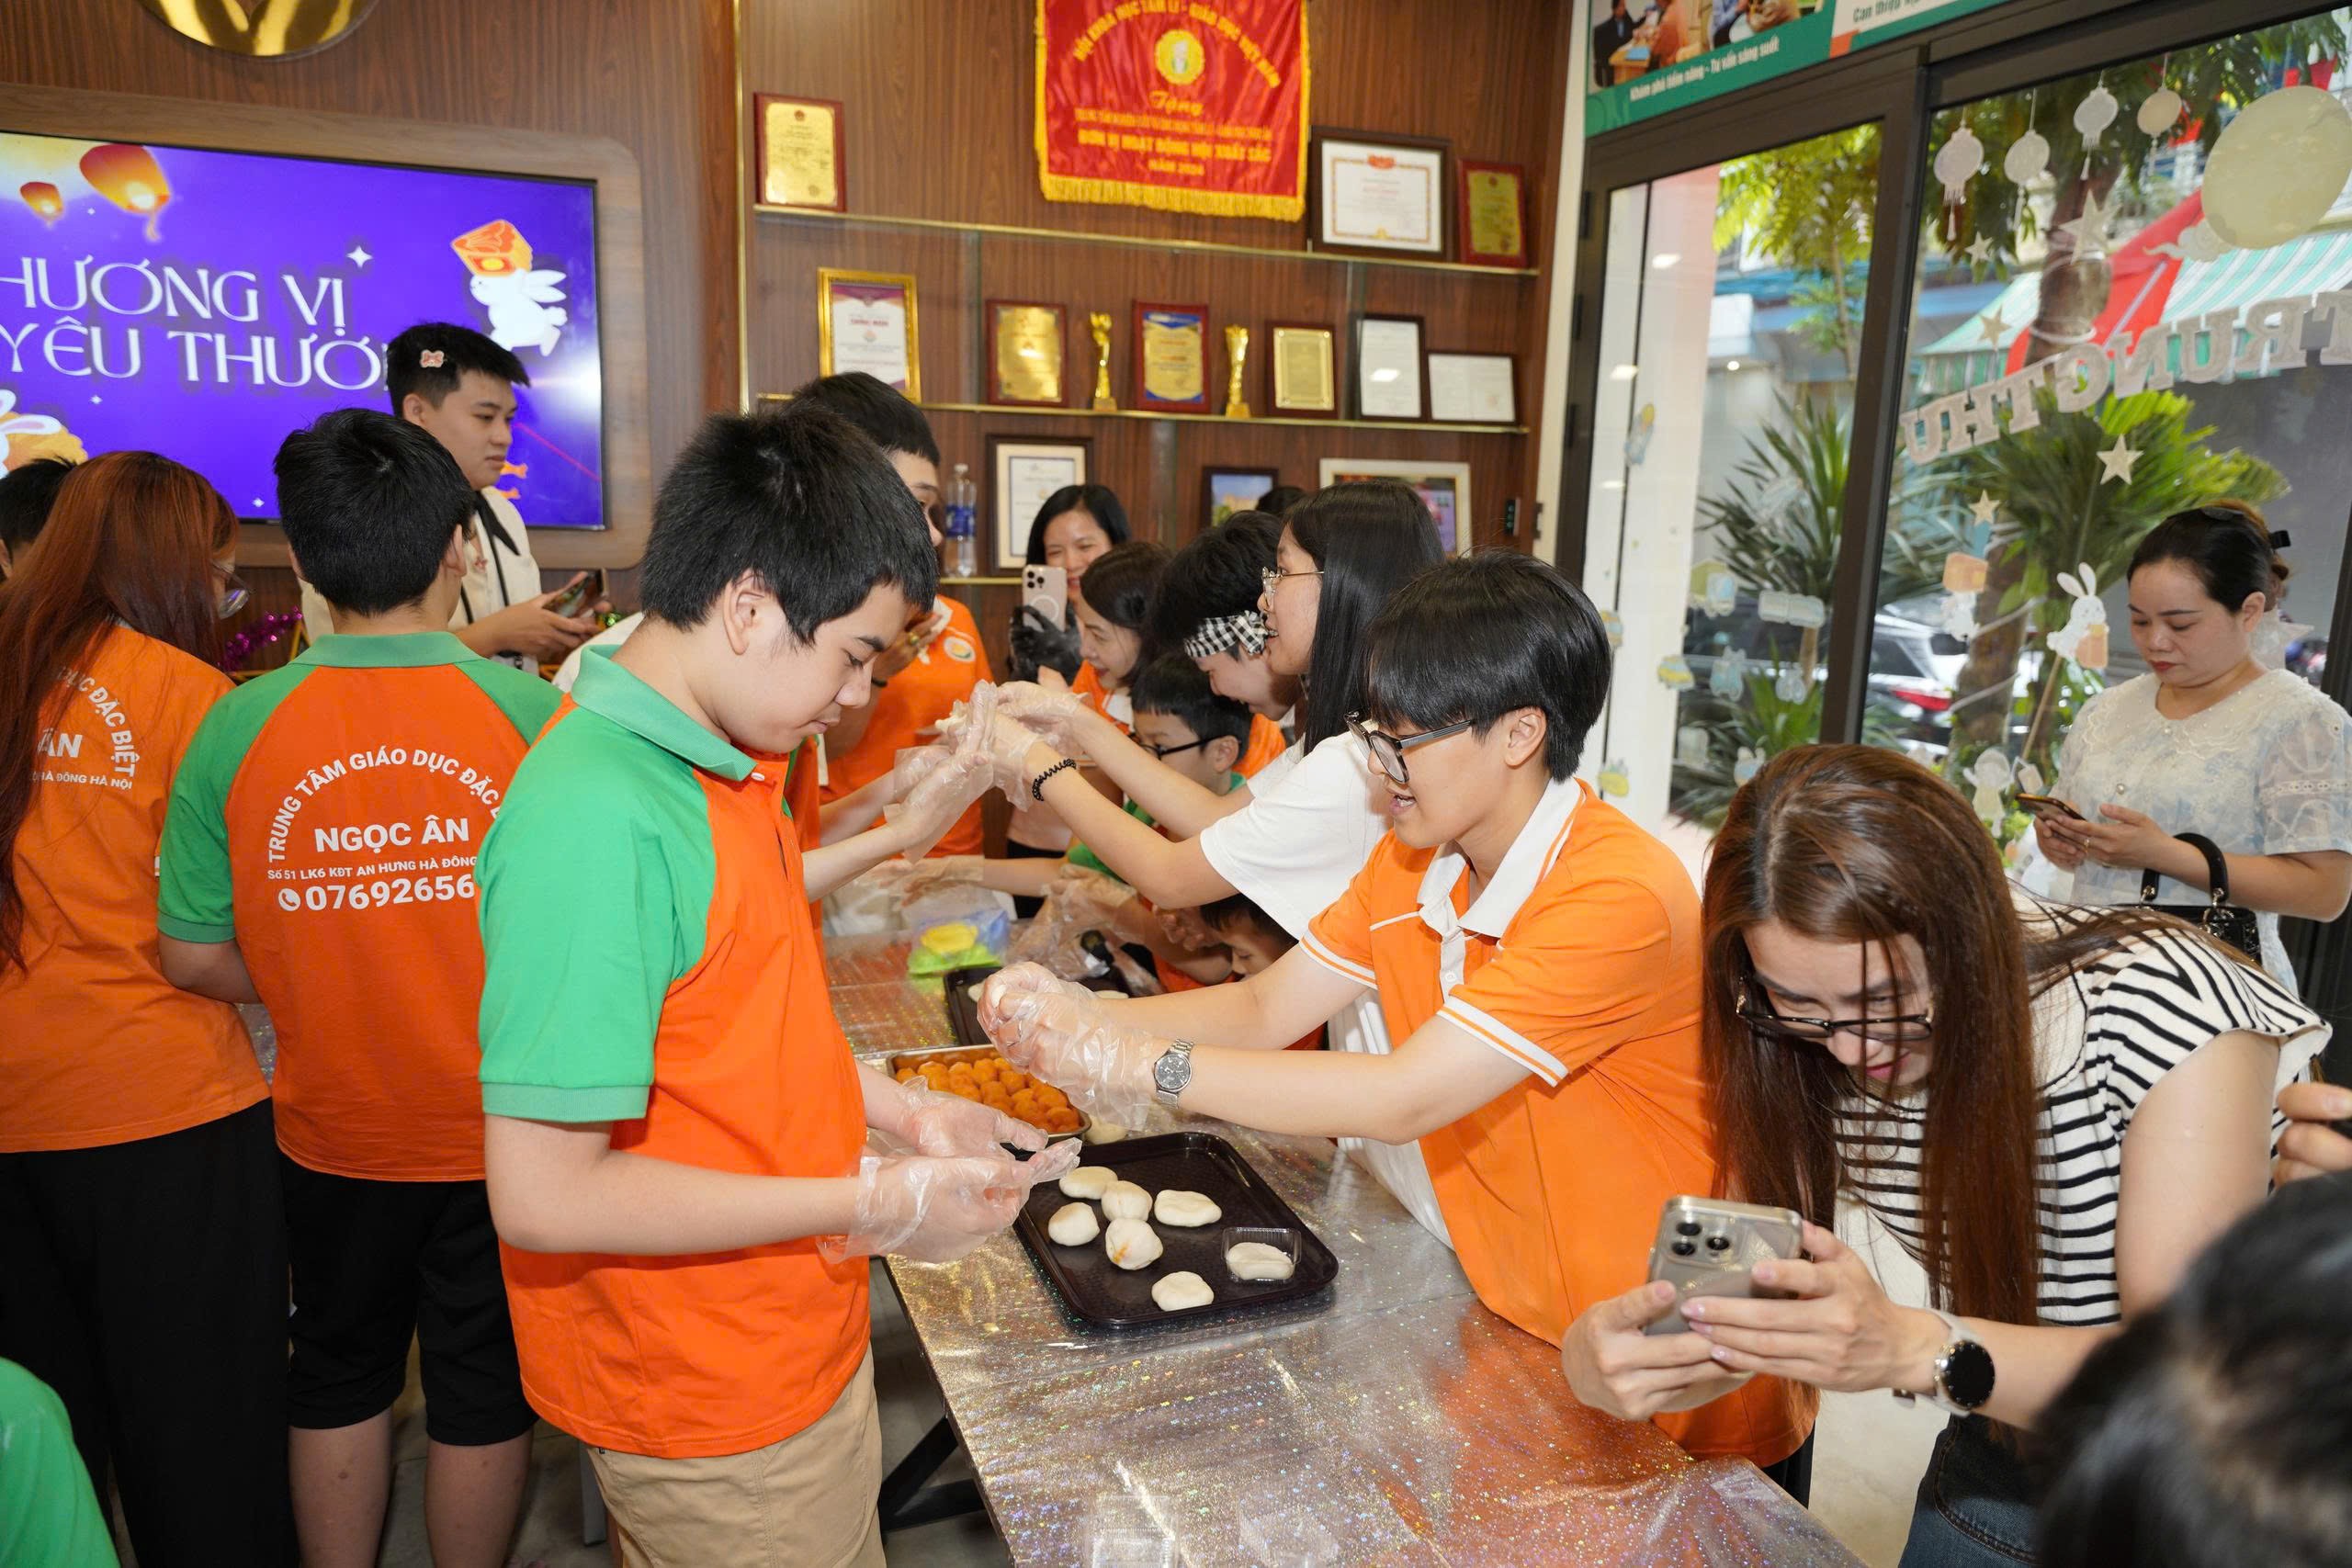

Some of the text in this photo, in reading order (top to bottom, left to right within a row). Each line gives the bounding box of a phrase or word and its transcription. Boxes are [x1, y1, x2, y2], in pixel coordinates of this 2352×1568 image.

[281, 274, 345, 337] VỊ
[0, 315, 389, 391] YÊU THƯƠ
[88, 686, 126, 728] ĐẶC
[111, 729, 140, 777] BIỆT
[89, 774, 108, 785] HÀ
[110, 778, 133, 790] NỘI
[268, 745, 499, 863] TRUNG TÂM GIÁO DỤC ĐẶC
[314, 814, 469, 854] NGỌC ÂN
[284, 870, 296, 880] 51
[300, 867, 326, 880] LK6
[356, 864, 376, 876] AN
[378, 860, 416, 874] HƯNG
[419, 857, 439, 871] HÀ
[441, 854, 478, 869] ĐÔNG
